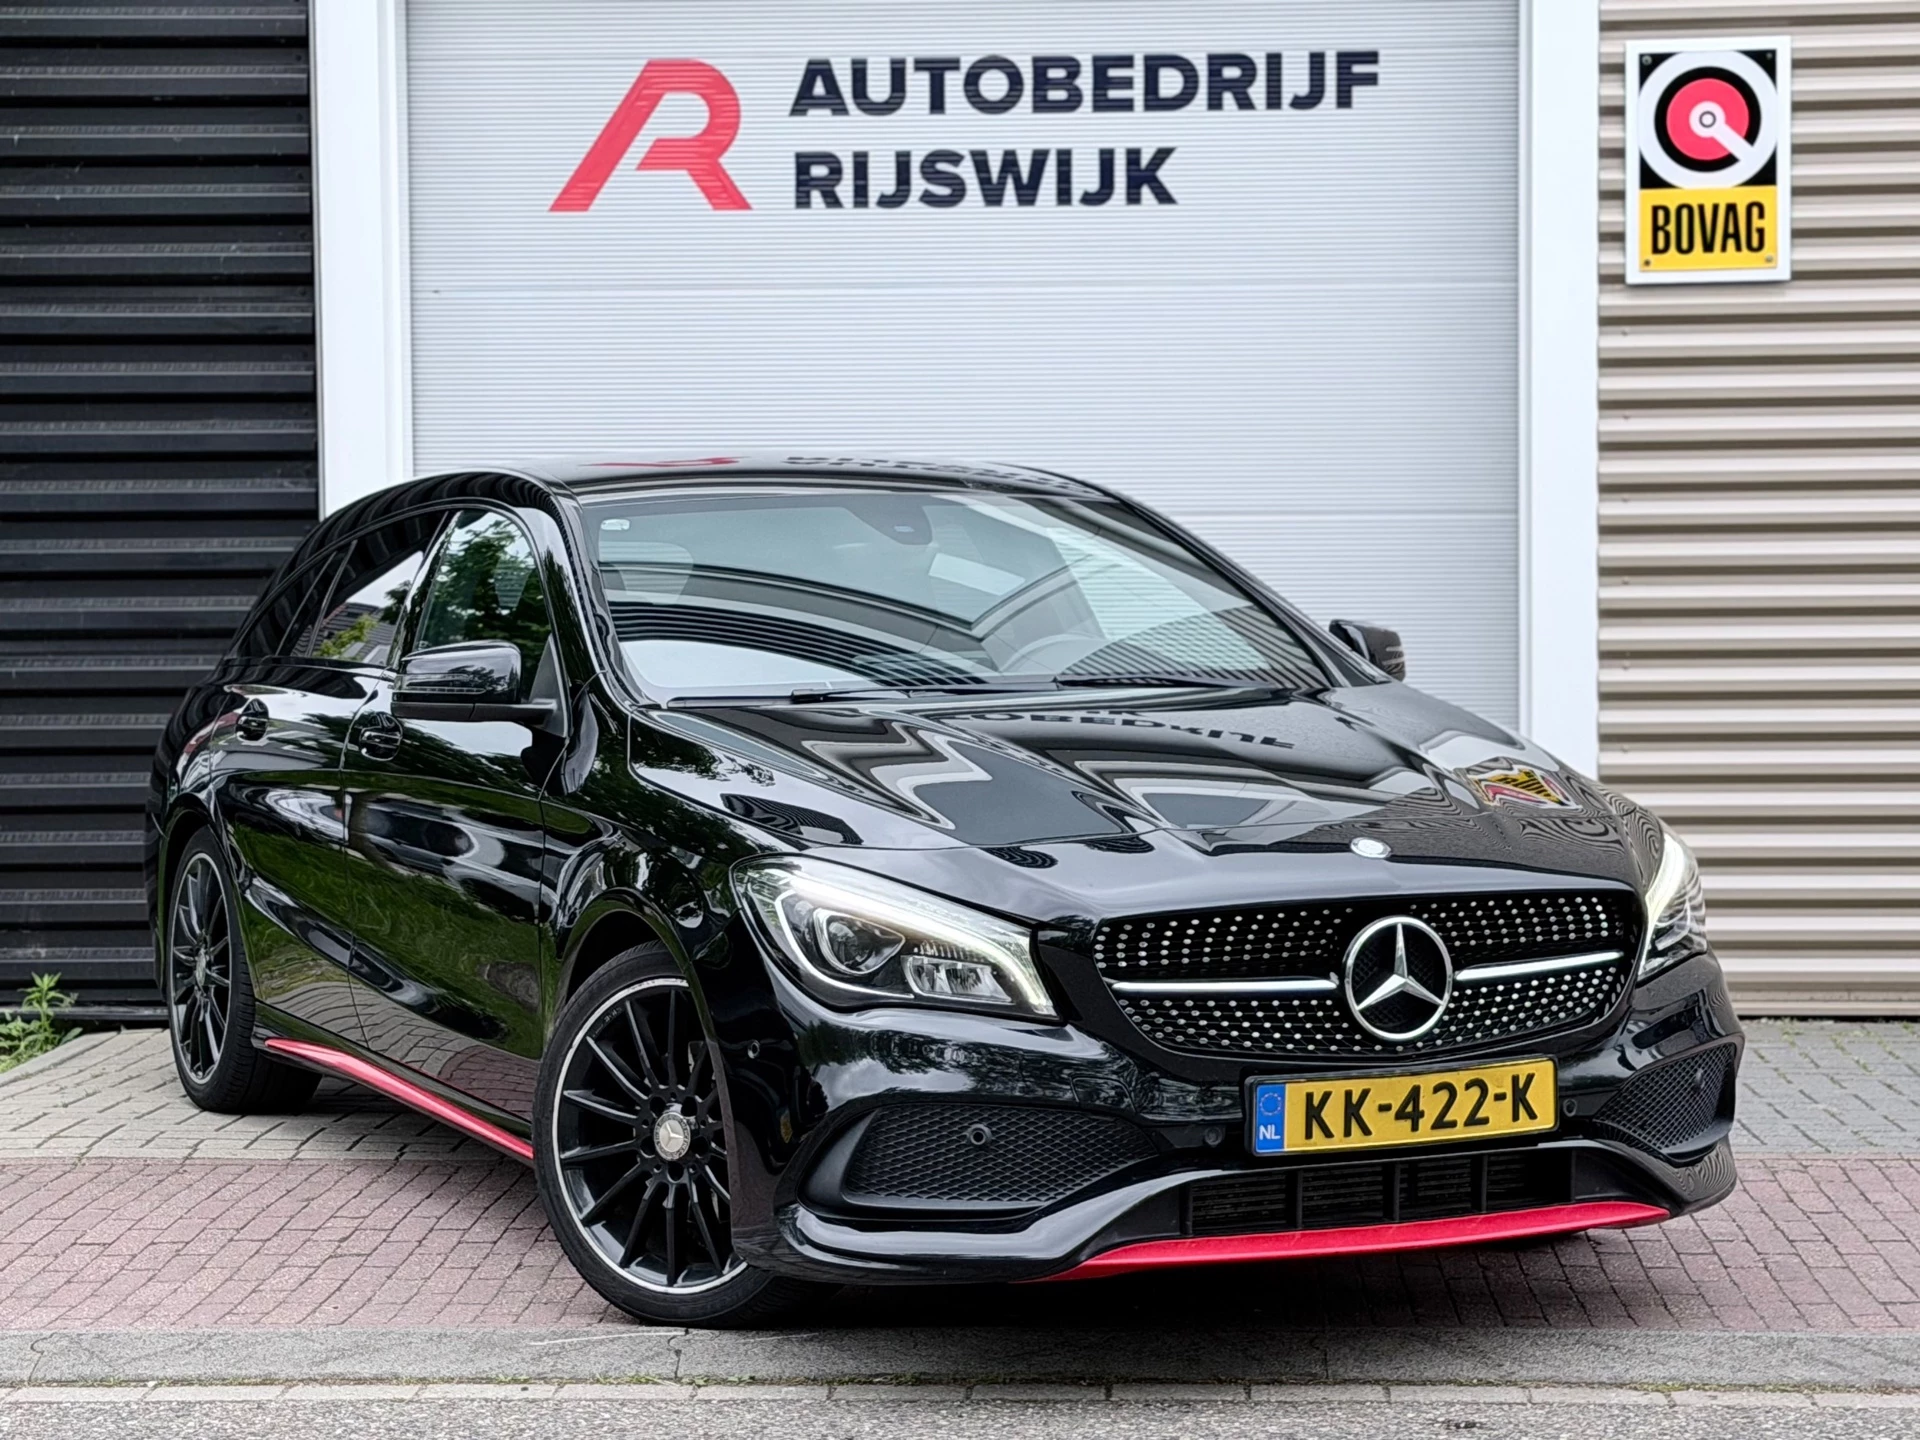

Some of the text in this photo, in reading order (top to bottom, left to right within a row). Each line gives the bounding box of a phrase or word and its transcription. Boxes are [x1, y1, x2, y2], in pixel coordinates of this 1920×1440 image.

[789, 50, 1380, 117] AUTOBEDRIJF
[794, 147, 1178, 209] RIJSWIJK
[1651, 201, 1765, 255] BOVAG
[1259, 1124, 1281, 1140] NL
[1304, 1072, 1538, 1140] KK-422-K
